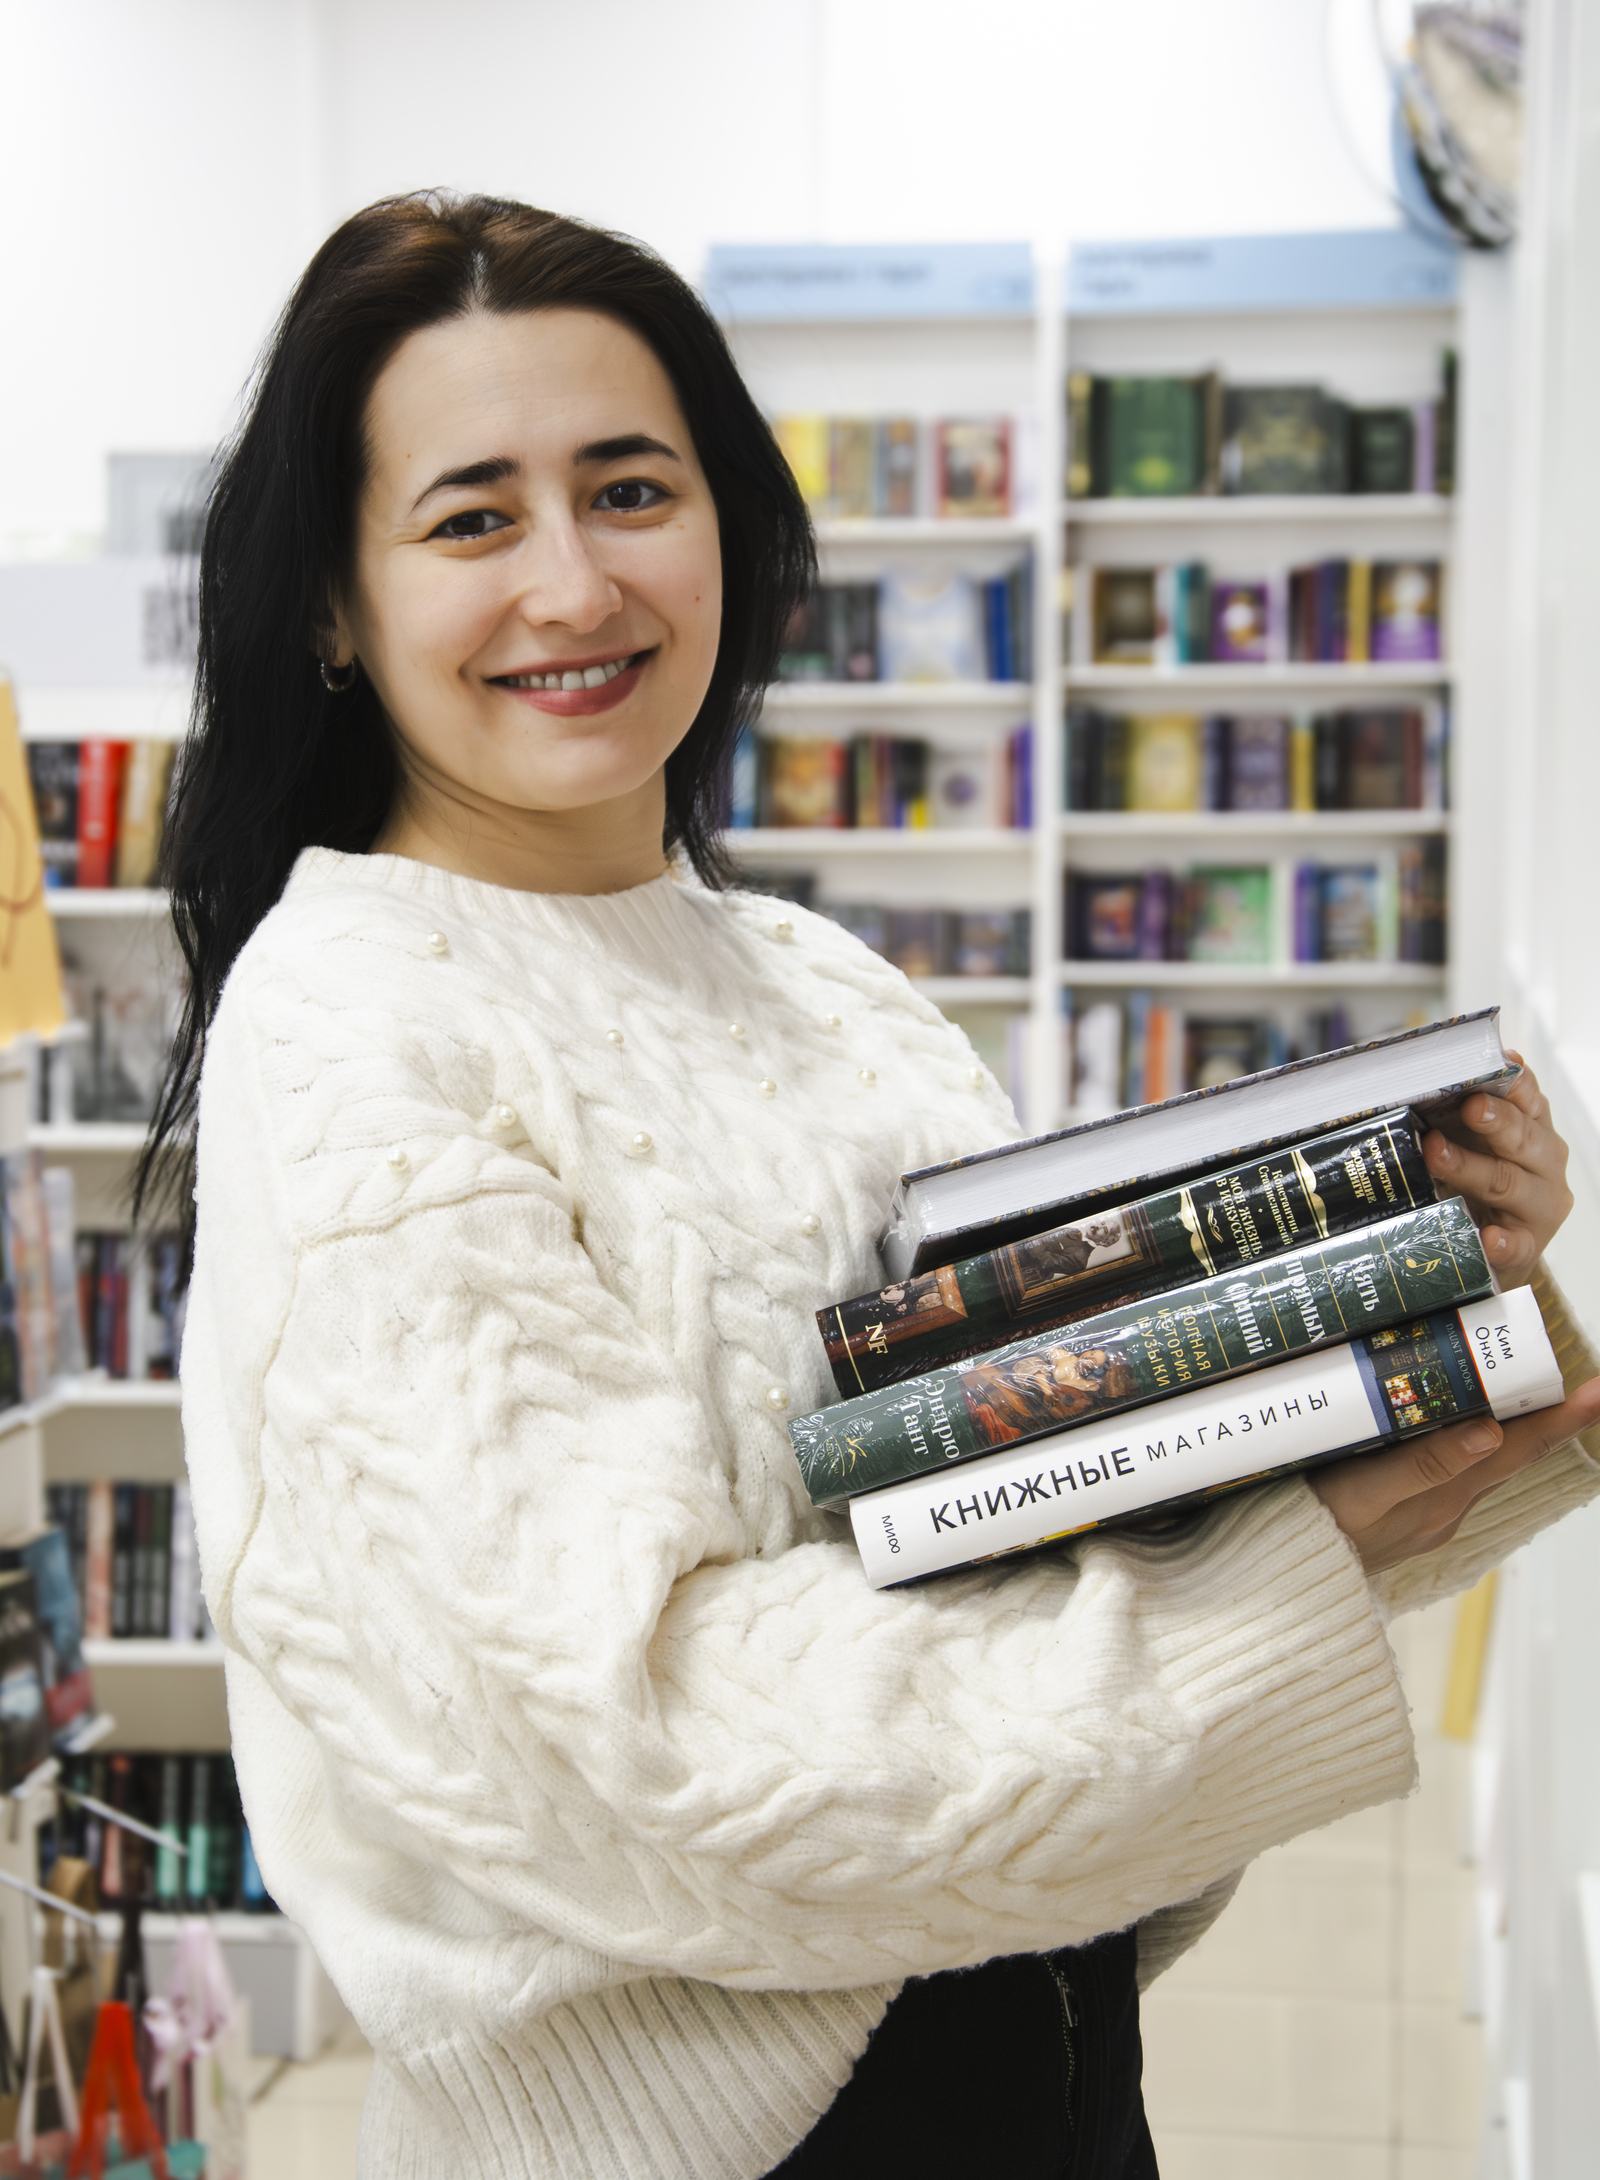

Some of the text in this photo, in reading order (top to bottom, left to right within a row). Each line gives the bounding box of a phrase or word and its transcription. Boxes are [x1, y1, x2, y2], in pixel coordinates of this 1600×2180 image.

[1271, 1169, 1299, 1234] Константин
[1344, 1159, 1366, 1199] КНИГИ
[1350, 1149, 1377, 1204] БОЛЬШИЕ
[1367, 1136, 1398, 1203] NON-FICTION
[1215, 1177, 1253, 1262] В ИСКУССТВЕ
[1228, 1175, 1263, 1255] МОЯ ЖИЗНЬ
[1258, 1165, 1294, 1246] Станиславский
[1285, 1260, 1327, 1343] прямых
[1350, 1253, 1380, 1312] Пять
[865, 1321, 889, 1354] NF
[1137, 1316, 1170, 1387] МУЗЫКИ
[1157, 1307, 1192, 1382] ИСТОРИЯ
[1179, 1305, 1212, 1371] ПОЛНАЯ
[1228, 1284, 1274, 1356] иний
[1475, 1326, 1497, 1370] Онхо
[1494, 1324, 1514, 1360] Ким
[1445, 1323, 1476, 1392] DAUNT BOOKS
[900, 1396, 929, 1456] Гант
[924, 1379, 960, 1460] Эндрю
[929, 1390, 1329, 1534] КНИЖНЫЕ МАГАЗИНЫ
